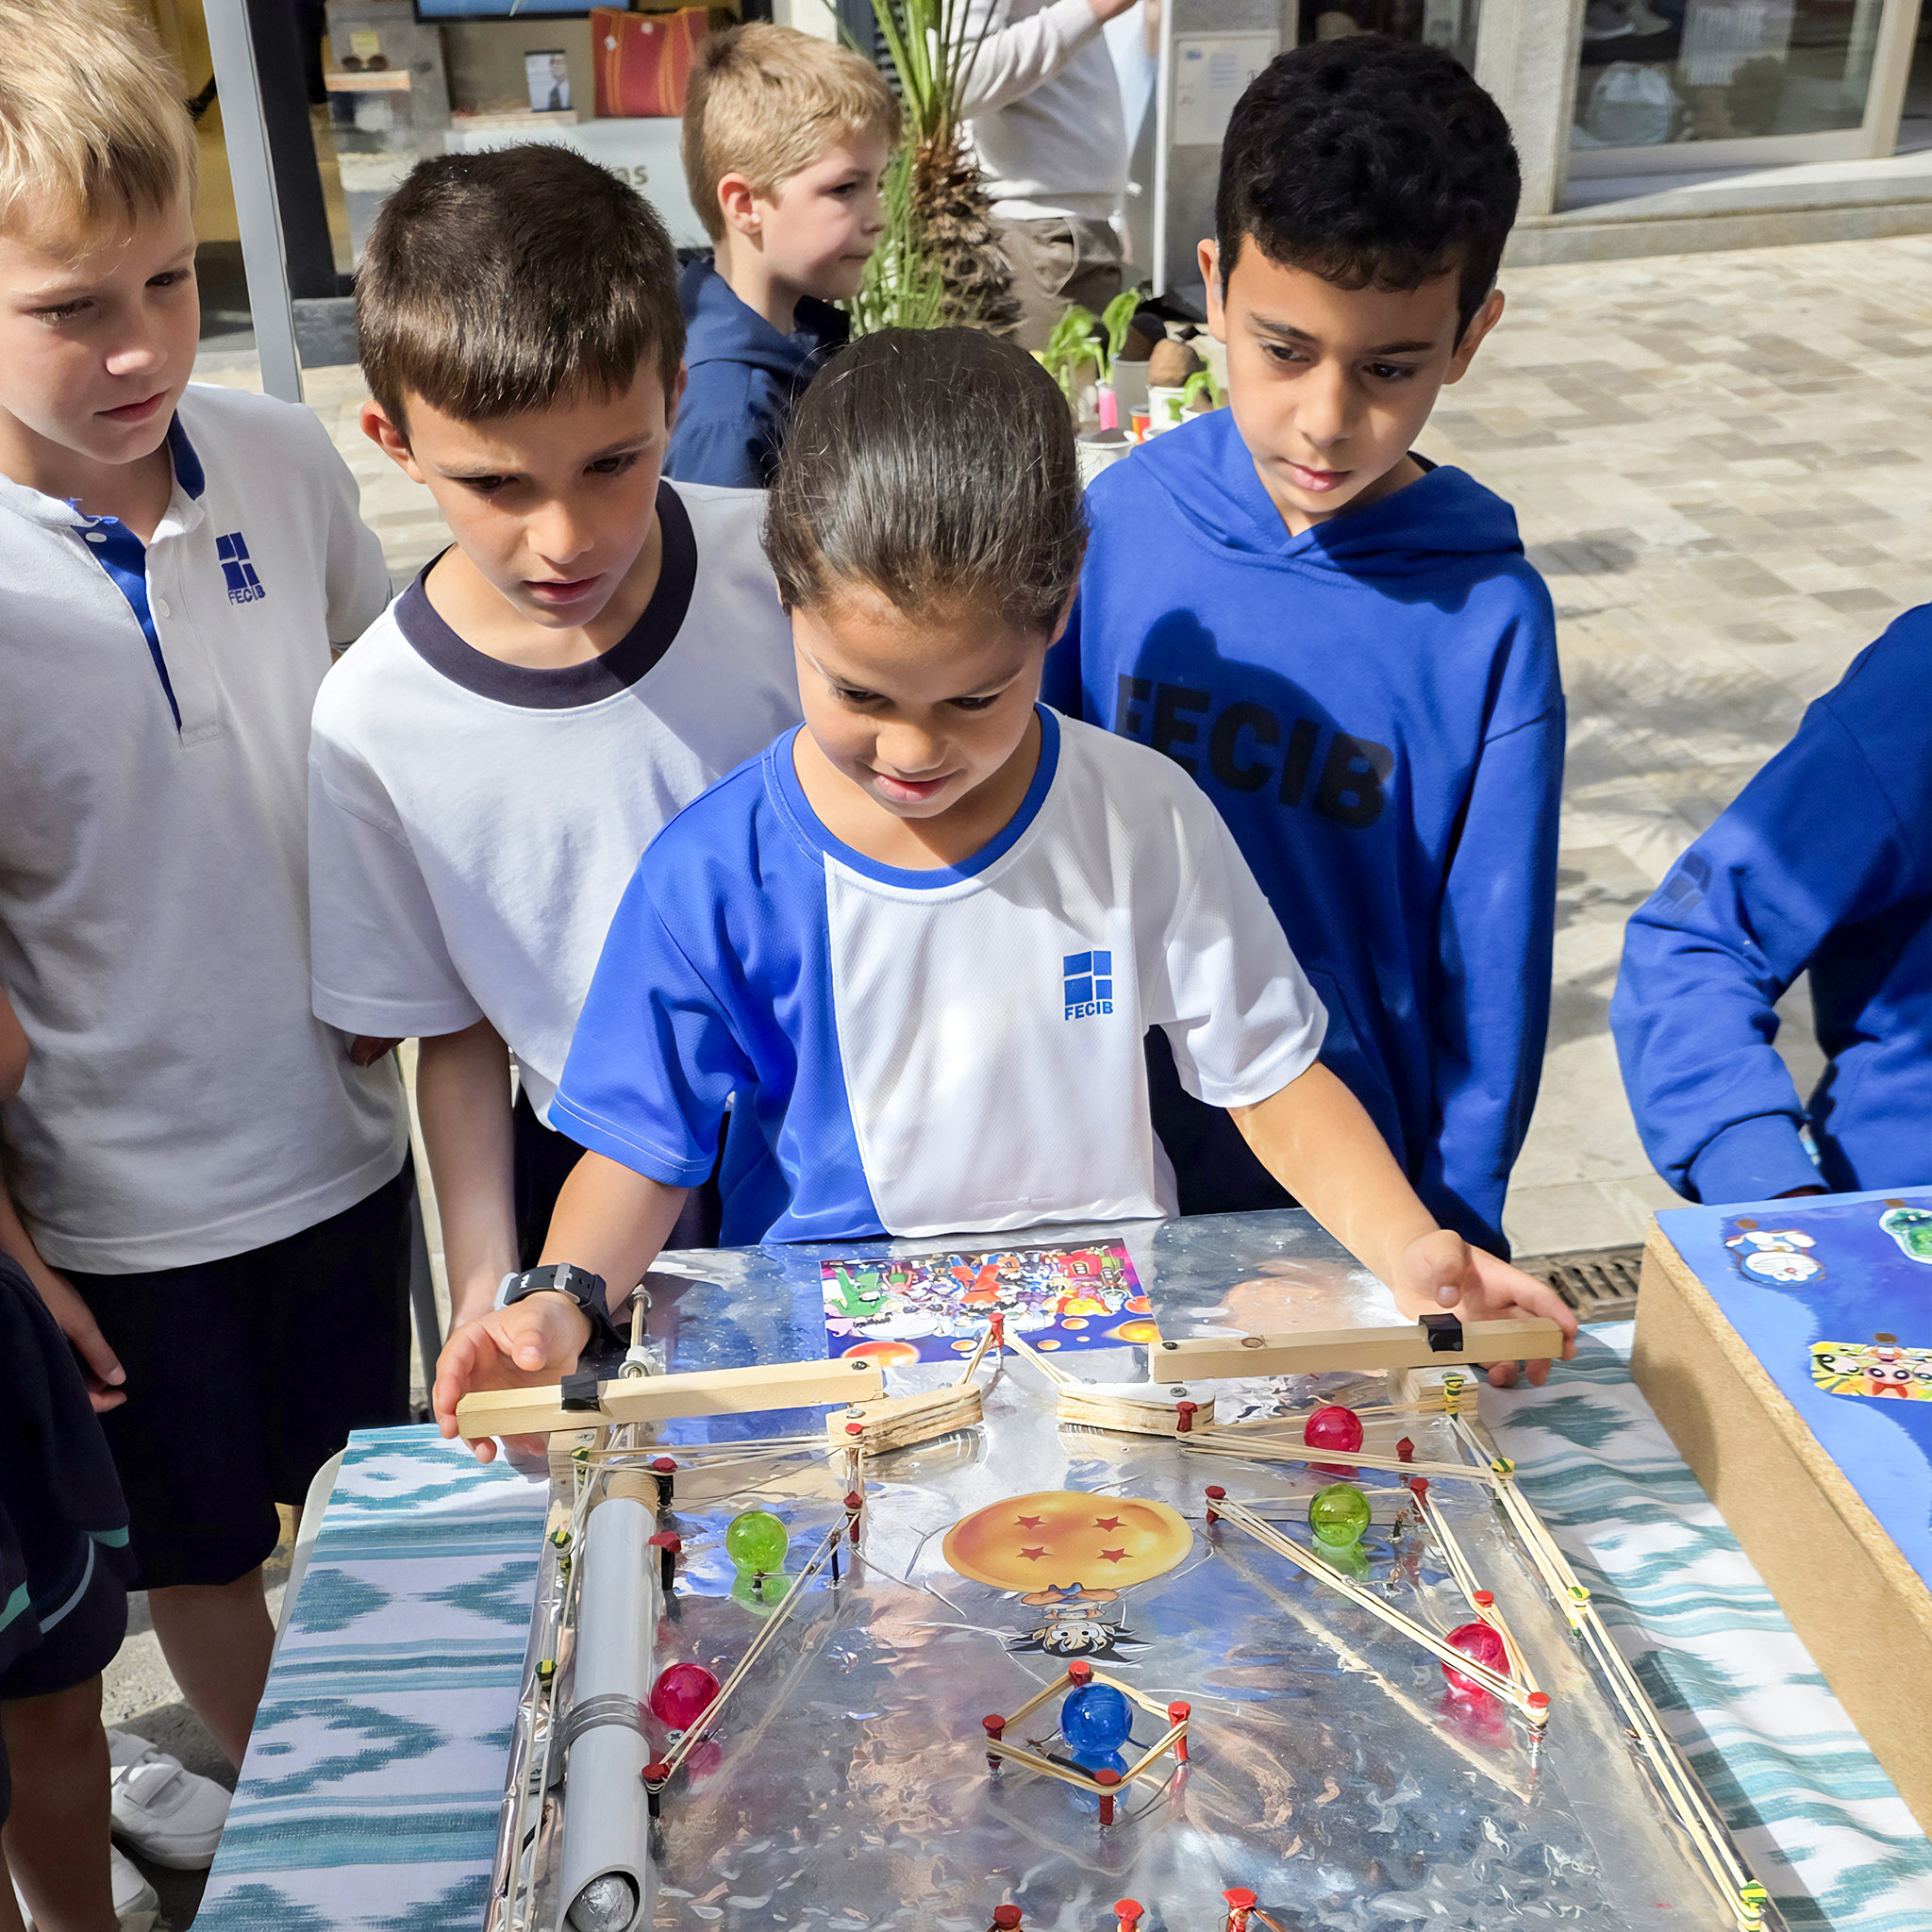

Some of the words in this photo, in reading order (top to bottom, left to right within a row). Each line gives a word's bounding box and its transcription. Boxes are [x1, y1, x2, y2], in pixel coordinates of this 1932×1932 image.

[227, 584, 266, 606] FECIB
[1116, 674, 1394, 829] FECIB
[1064, 1000, 1114, 1021] FECIB
